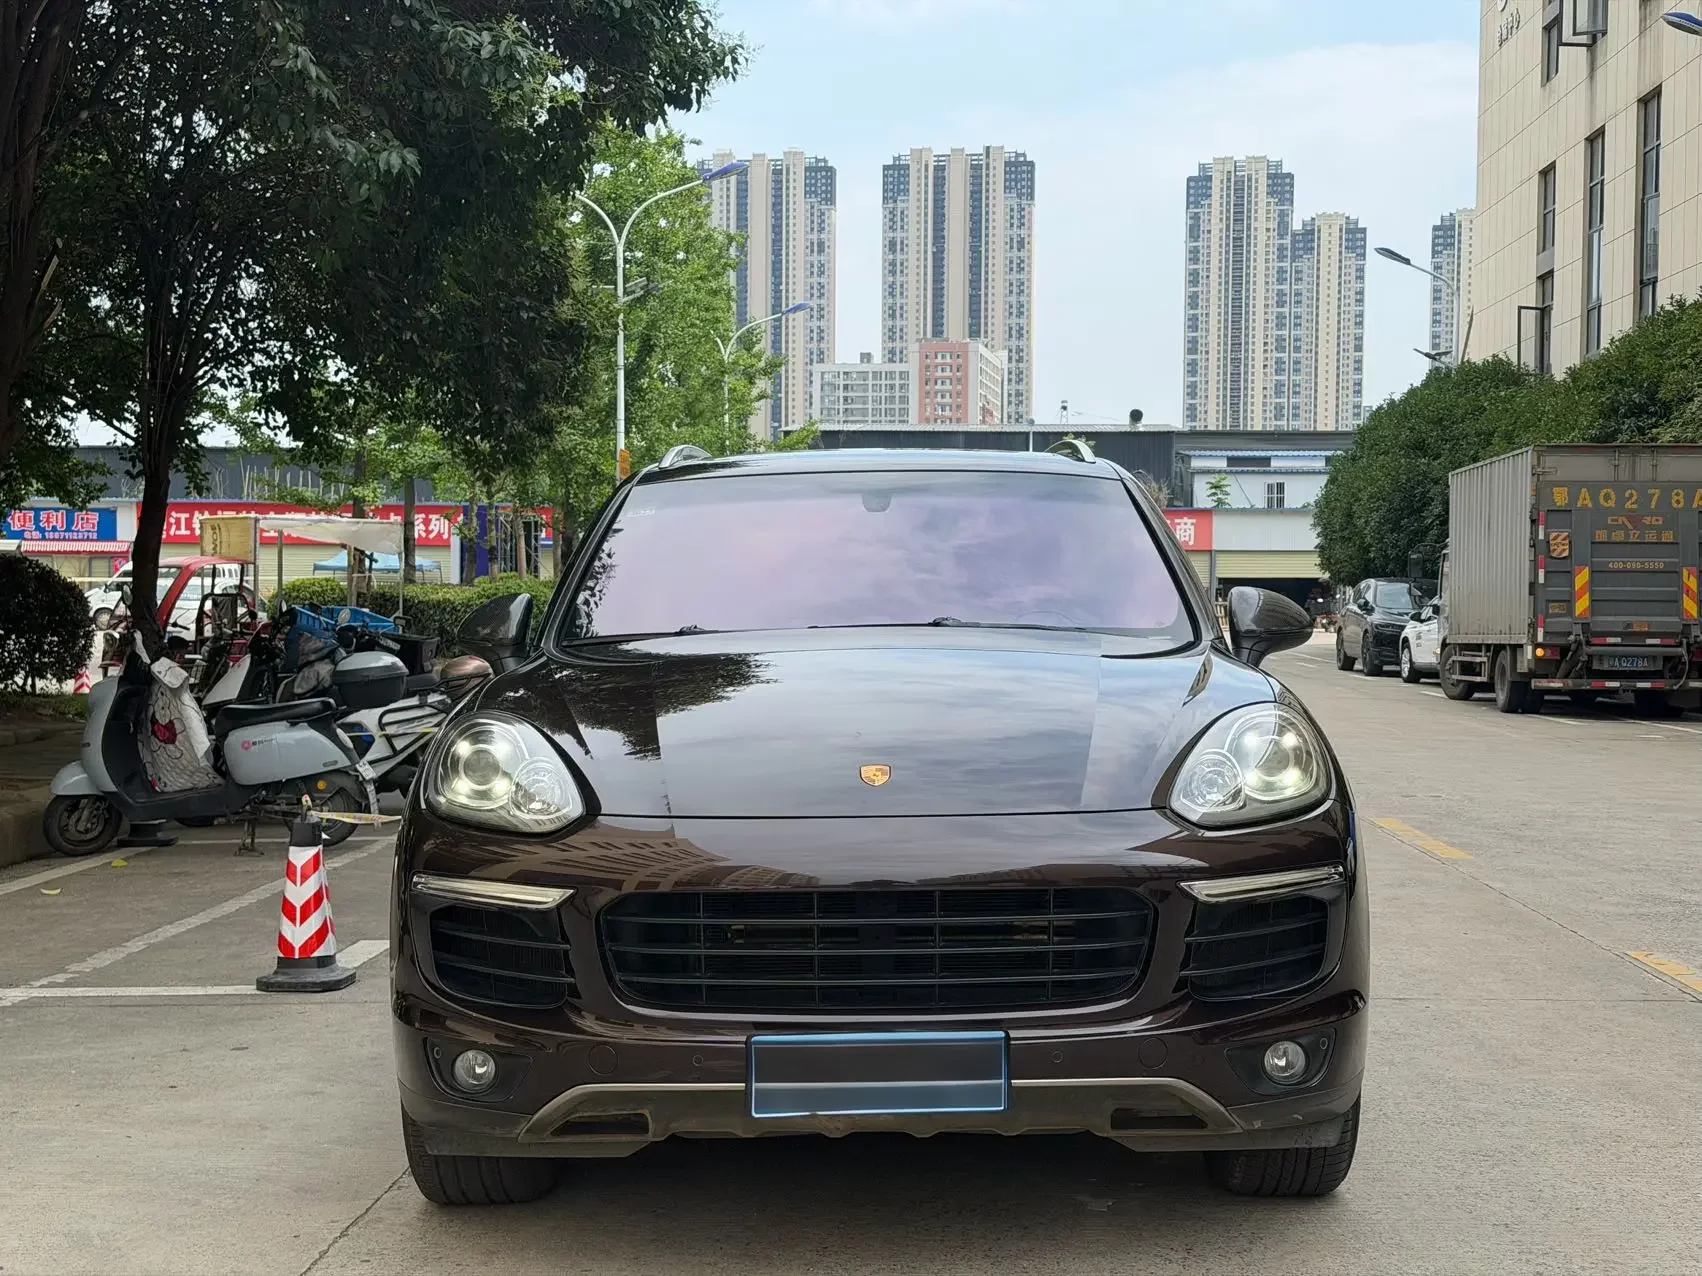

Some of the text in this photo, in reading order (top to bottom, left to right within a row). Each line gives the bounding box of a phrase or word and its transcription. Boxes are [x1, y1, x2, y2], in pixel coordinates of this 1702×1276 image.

[8, 510, 99, 531] 便利店
[1167, 516, 1197, 545] 商
